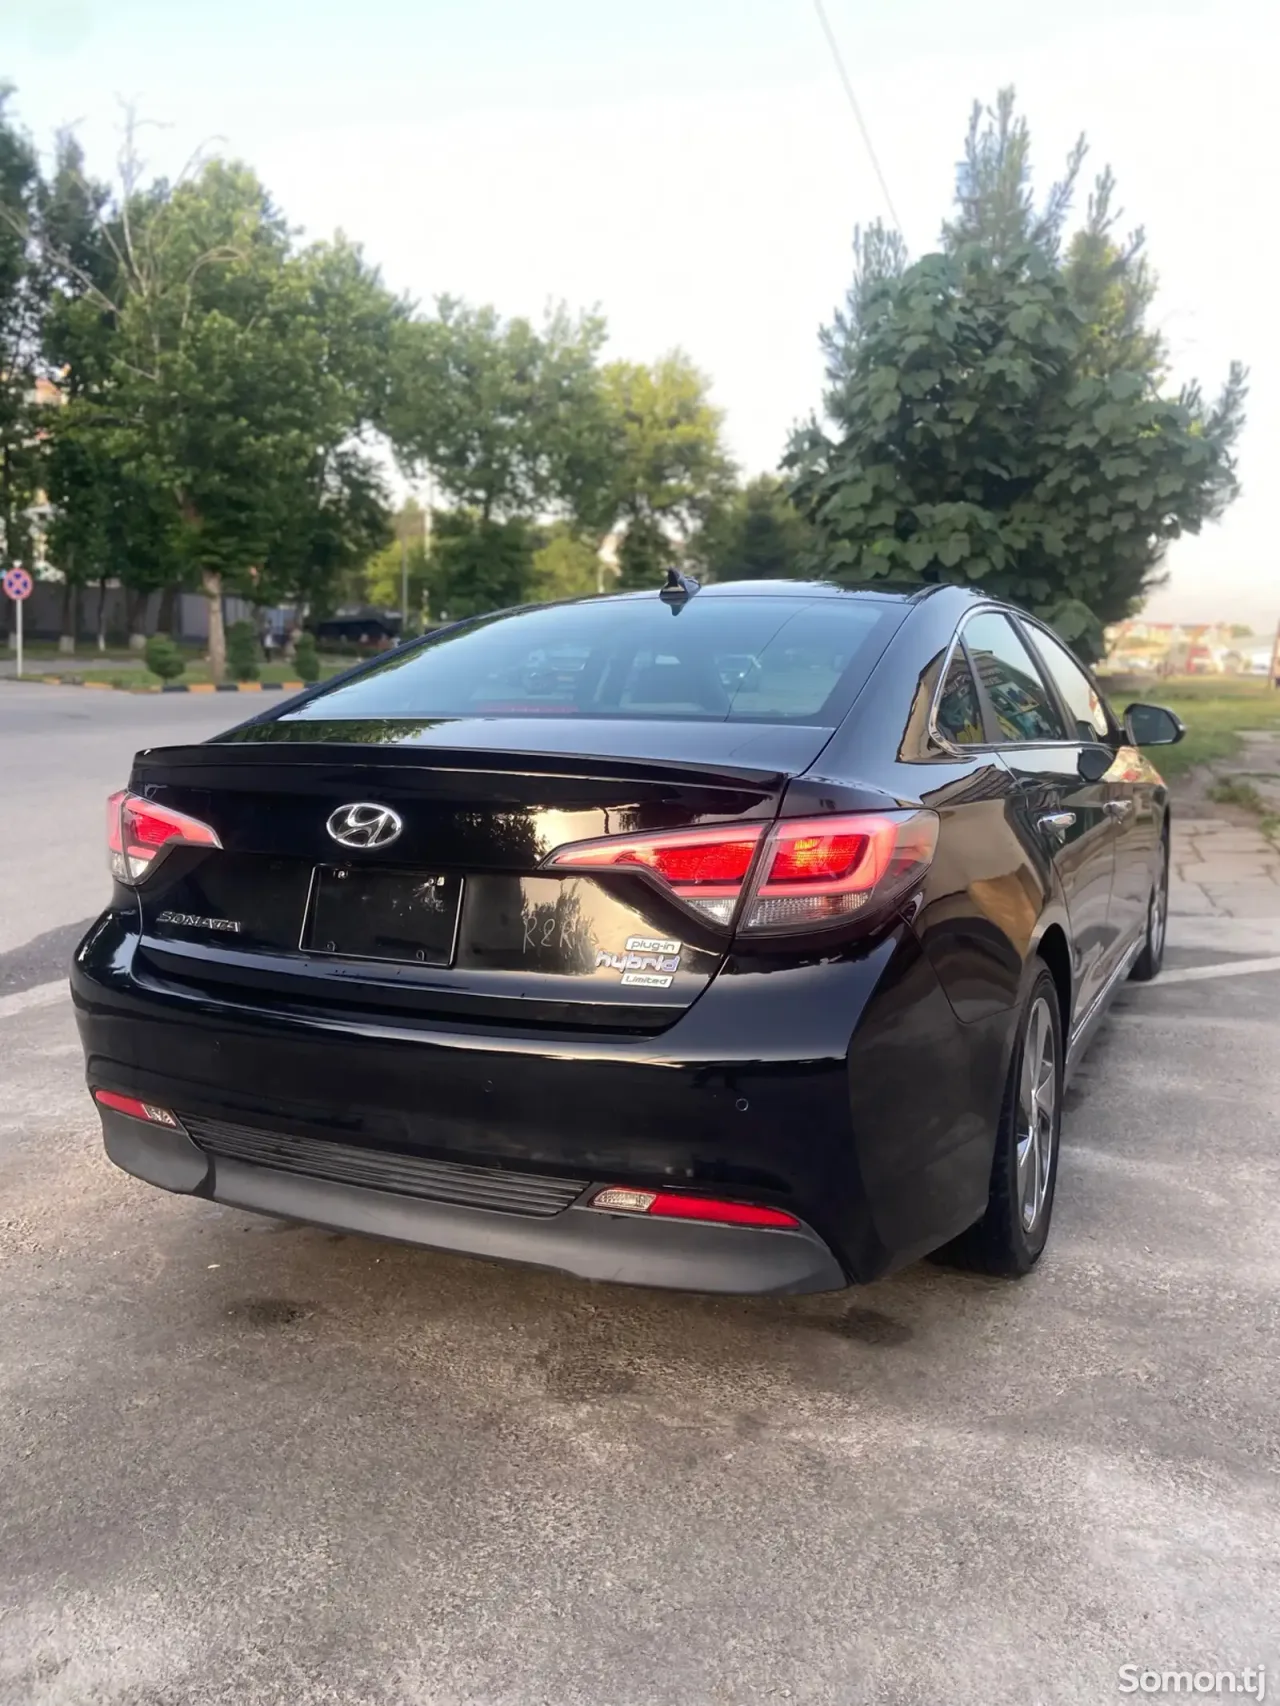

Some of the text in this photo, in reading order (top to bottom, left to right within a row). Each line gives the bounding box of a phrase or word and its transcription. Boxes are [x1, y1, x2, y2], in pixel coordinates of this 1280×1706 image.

[156, 911, 241, 932] SONATA
[631, 939, 675, 951] plug-in
[595, 950, 680, 973] hybrid
[626, 975, 669, 985] Limited
